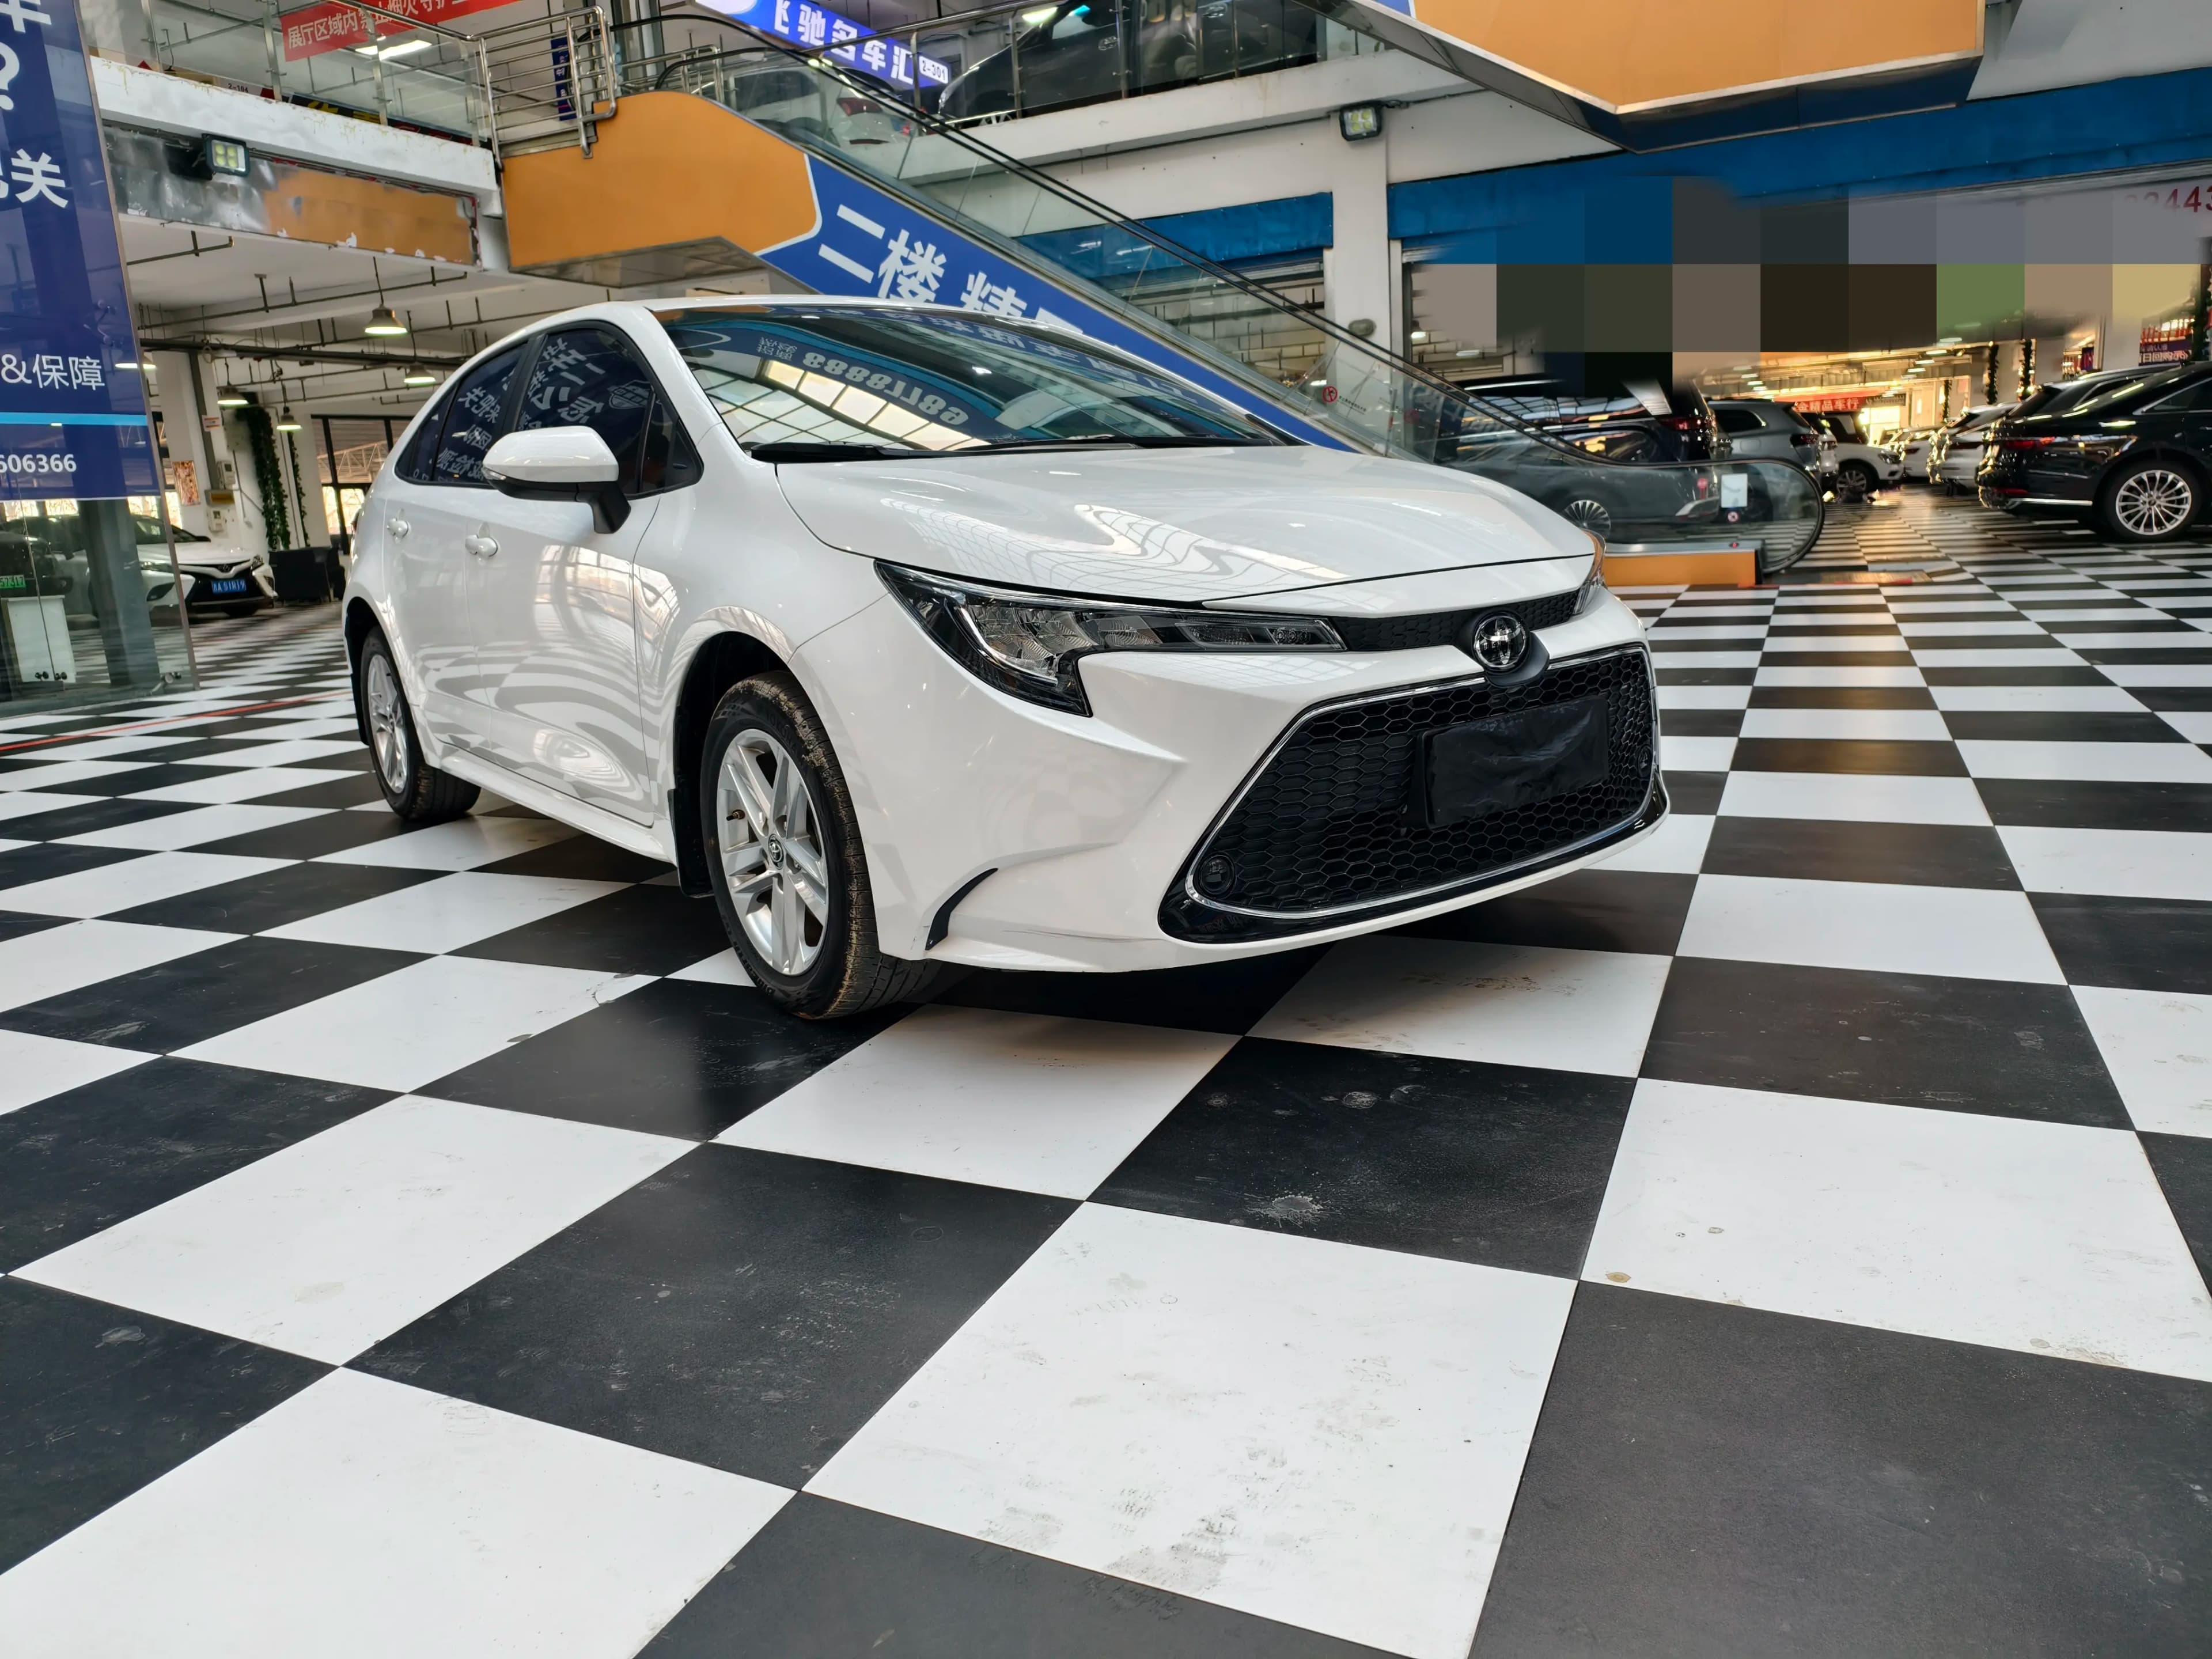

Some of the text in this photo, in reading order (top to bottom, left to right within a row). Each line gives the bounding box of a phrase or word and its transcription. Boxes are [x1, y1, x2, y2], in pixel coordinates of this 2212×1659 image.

[921, 60, 946, 81] 2-301
[0, 149, 69, 209] 关
[818, 204, 946, 301] 二楼
[1, 354, 105, 391] &保障
